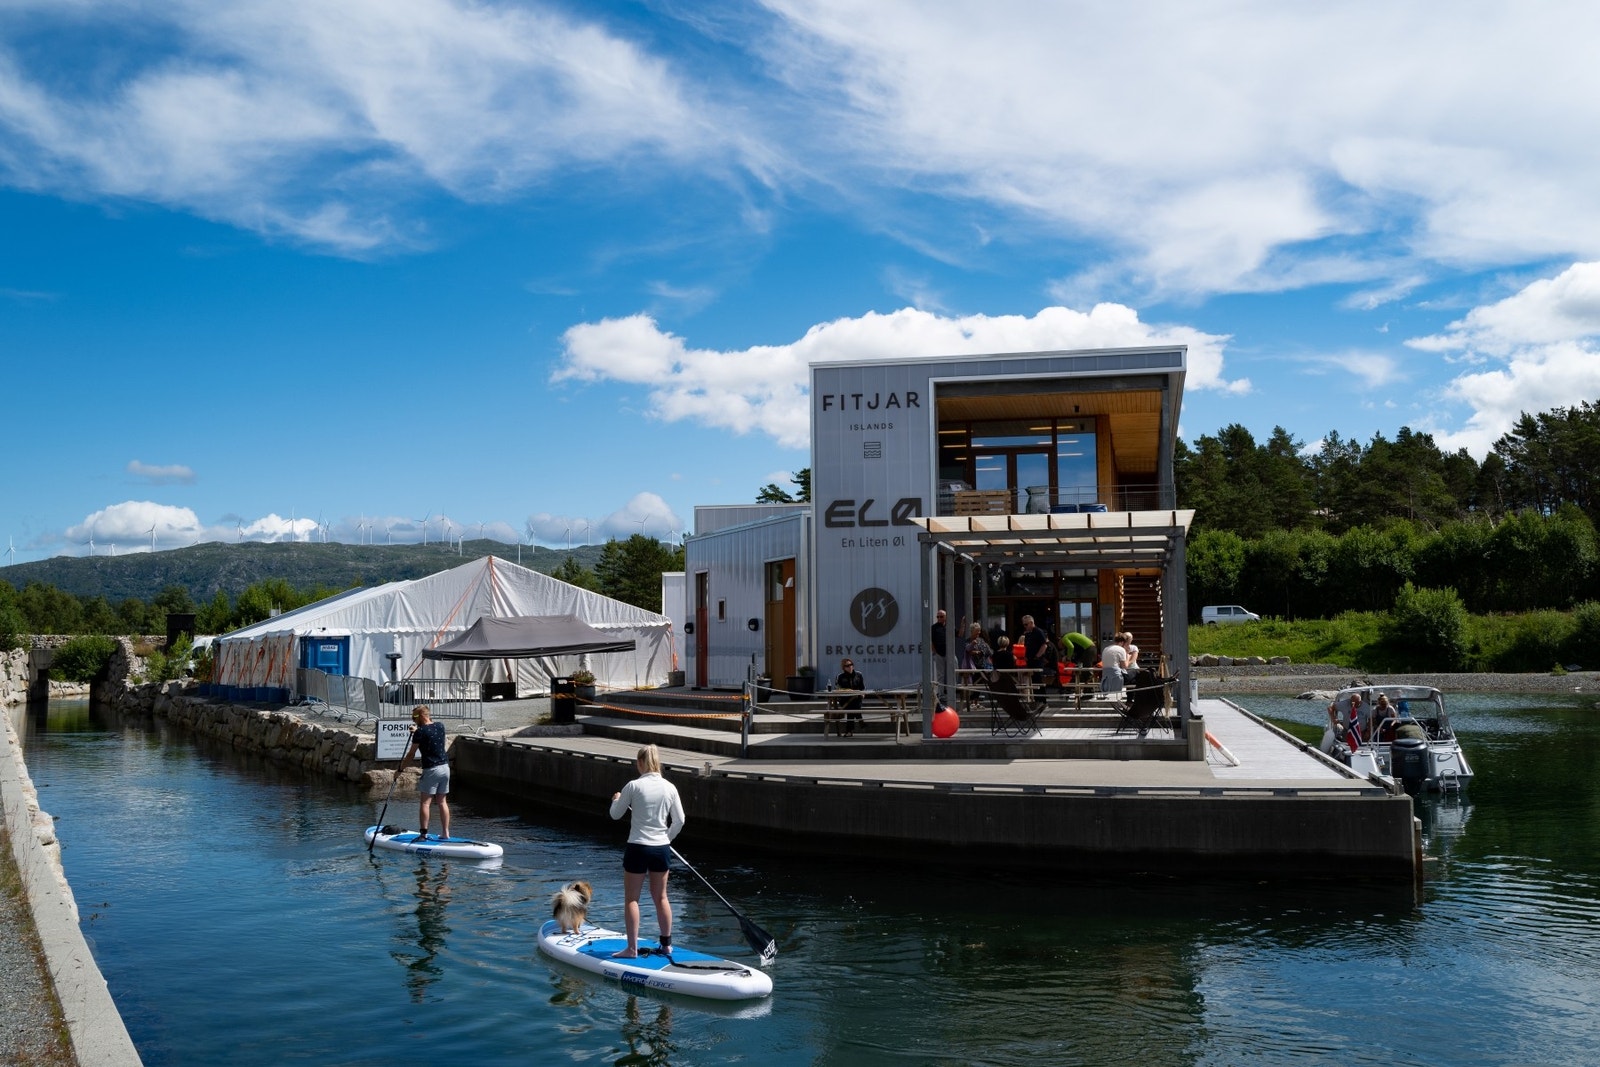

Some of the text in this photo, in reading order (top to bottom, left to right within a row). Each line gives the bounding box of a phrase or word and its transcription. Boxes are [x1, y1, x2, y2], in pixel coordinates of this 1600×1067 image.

[822, 391, 921, 412] FITJAR
[849, 422, 894, 431] ISLANDS
[841, 535, 905, 548] En Liten Øl
[382, 723, 411, 732] FORSIK
